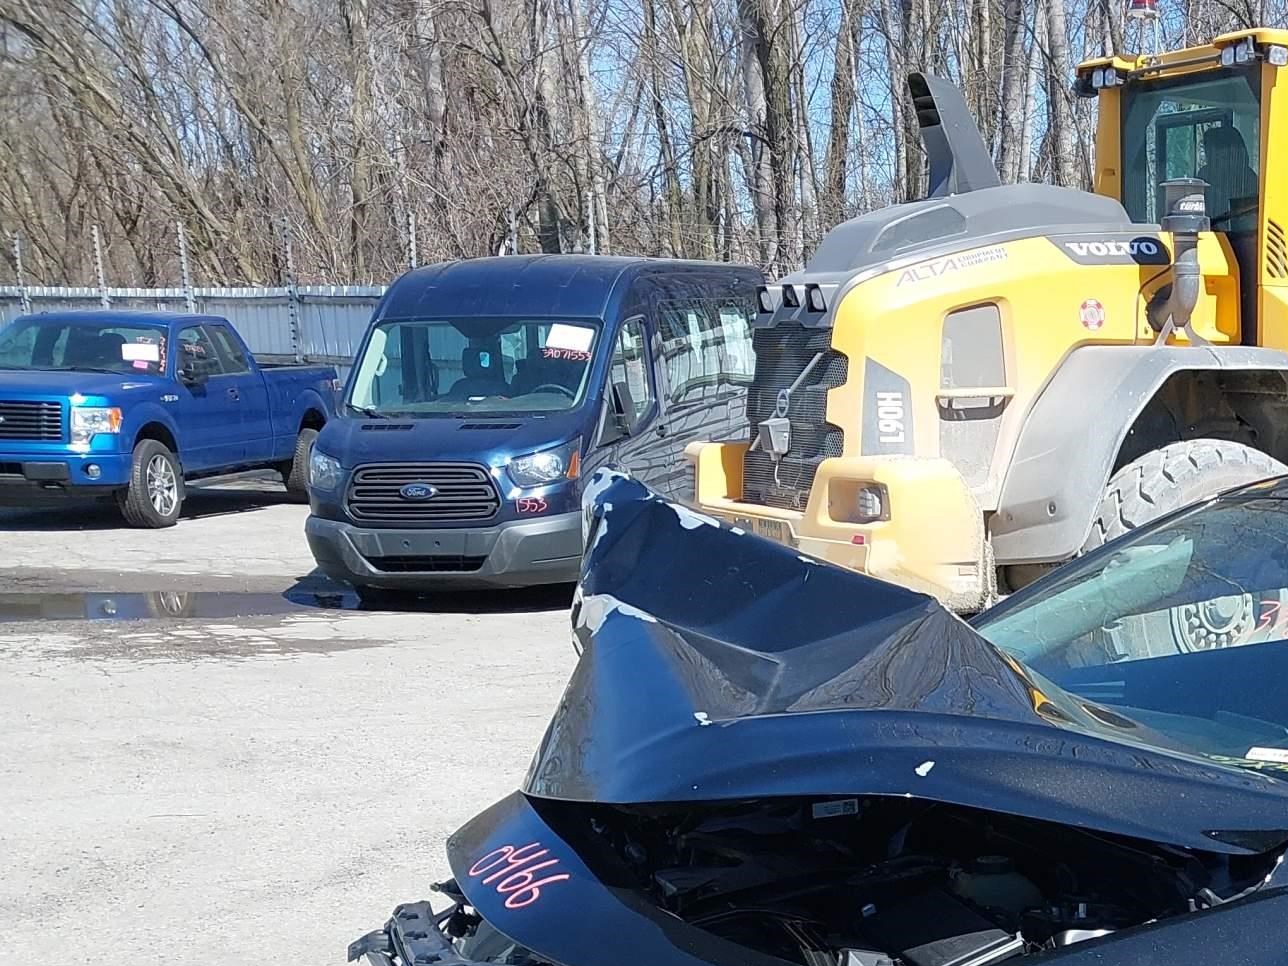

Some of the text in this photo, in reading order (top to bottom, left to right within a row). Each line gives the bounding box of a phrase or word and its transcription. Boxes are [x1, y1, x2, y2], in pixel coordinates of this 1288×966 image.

[1065, 240, 1158, 256] VOLVO
[896, 258, 960, 287] ALTA
[876, 391, 905, 443] L90H
[515, 497, 548, 513] 1553
[468, 842, 570, 908] 0466
